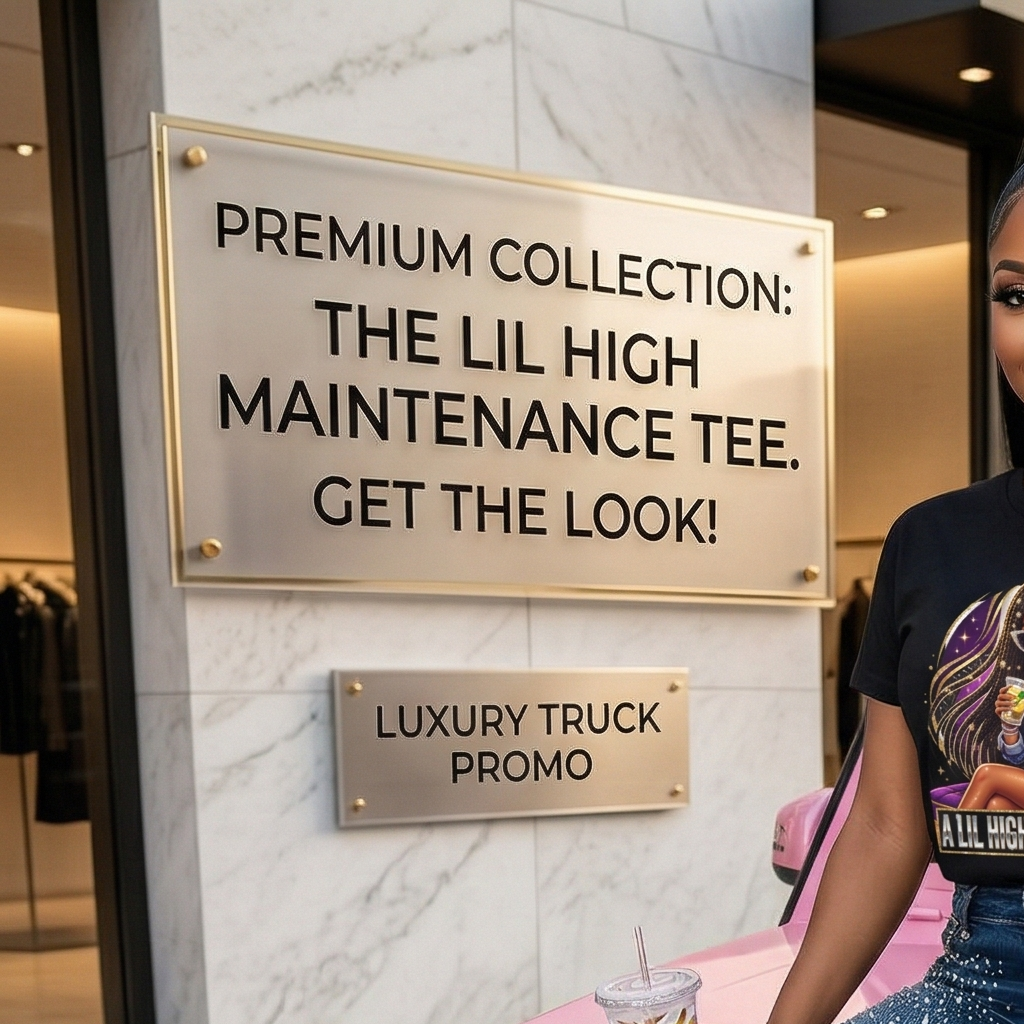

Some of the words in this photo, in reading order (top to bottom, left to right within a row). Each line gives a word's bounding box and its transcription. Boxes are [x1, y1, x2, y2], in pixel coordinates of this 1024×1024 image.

[216, 201, 472, 277] PREMIUM
[489, 237, 792, 316] COLLECTION:
[314, 299, 440, 366] THE
[462, 315, 545, 375] LIL
[564, 325, 699, 389] HIGH
[219, 373, 675, 464] MAINTENANCE
[690, 412, 800, 471] TEE.
[313, 475, 426, 529] GET
[440, 482, 548, 536] THE
[566, 490, 717, 545] LOOK!
[376, 703, 529, 739] LUXURY
[537, 702, 662, 736] TRUCK
[451, 748, 593, 784] PROMO
[942, 813, 955, 848] A
[956, 813, 985, 849] LIL
